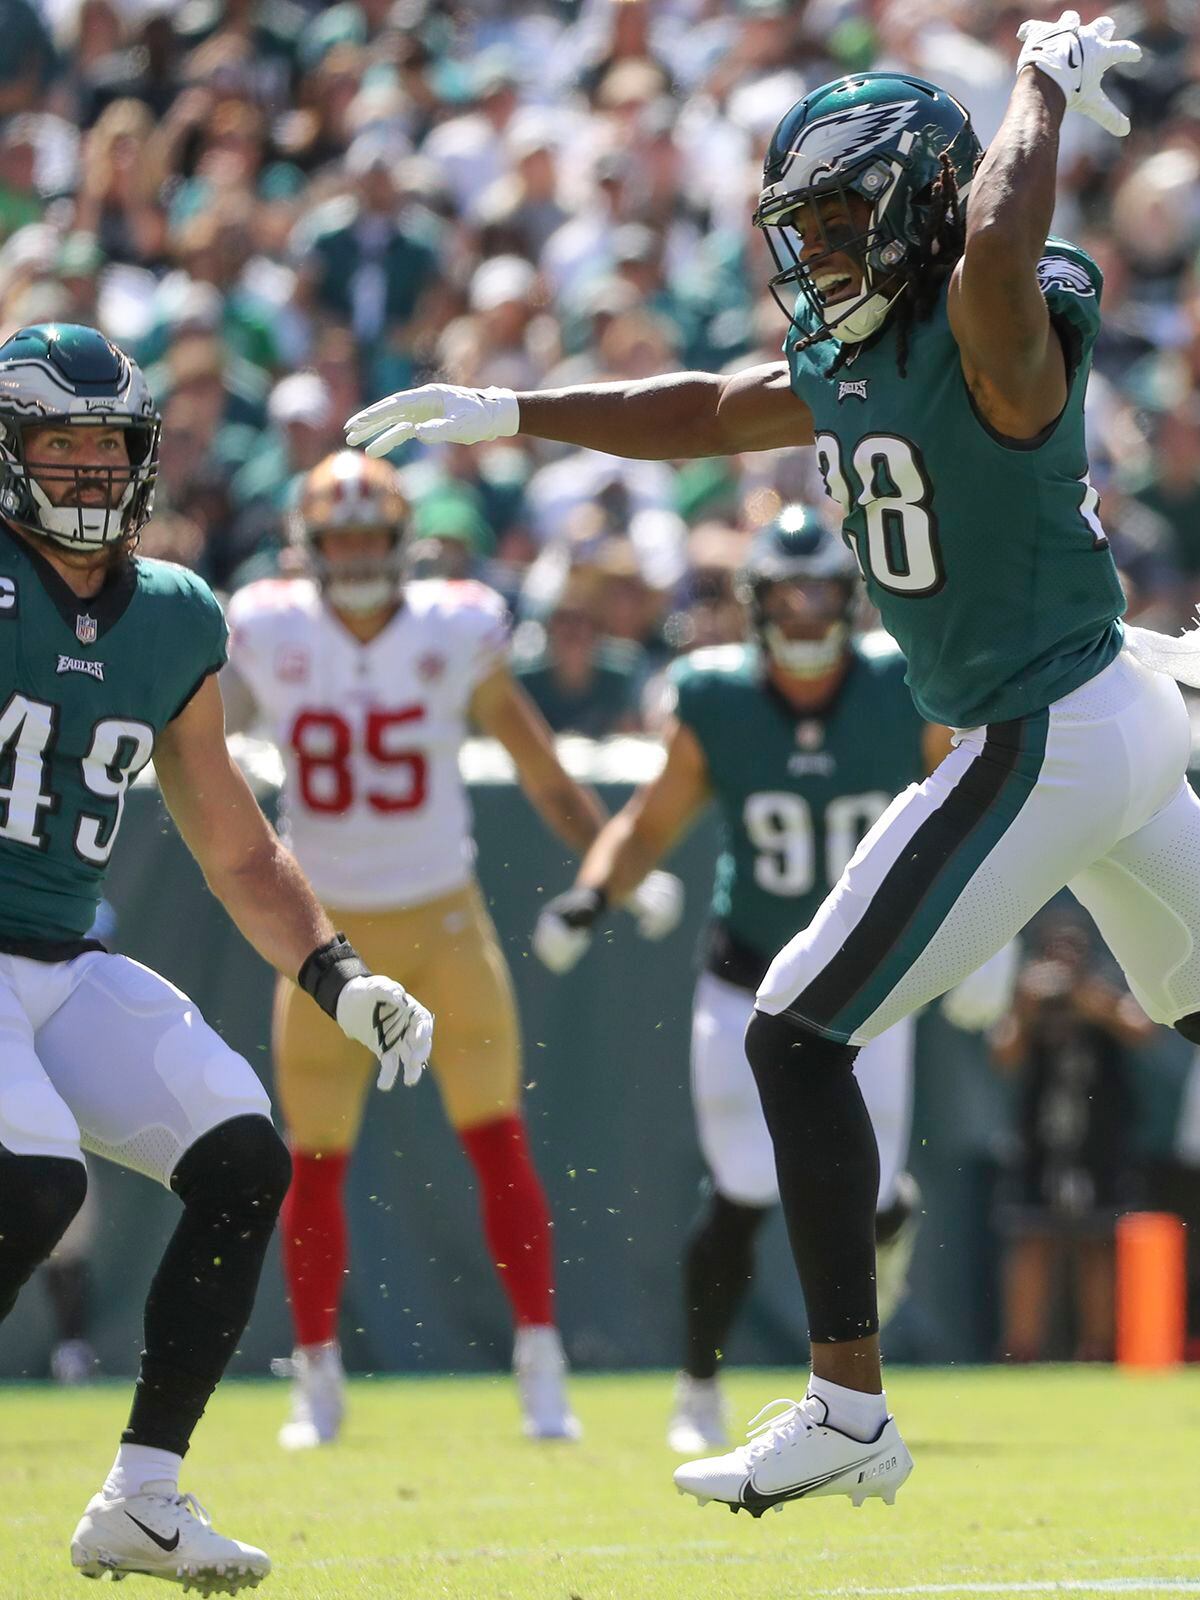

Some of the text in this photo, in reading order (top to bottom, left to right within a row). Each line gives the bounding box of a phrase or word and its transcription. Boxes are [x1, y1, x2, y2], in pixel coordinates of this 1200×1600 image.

[838, 380, 868, 400] EAGLES
[57, 654, 104, 681] EAGLES
[0, 692, 154, 862] 49
[290, 706, 427, 815] 85
[743, 791, 892, 897] 90
